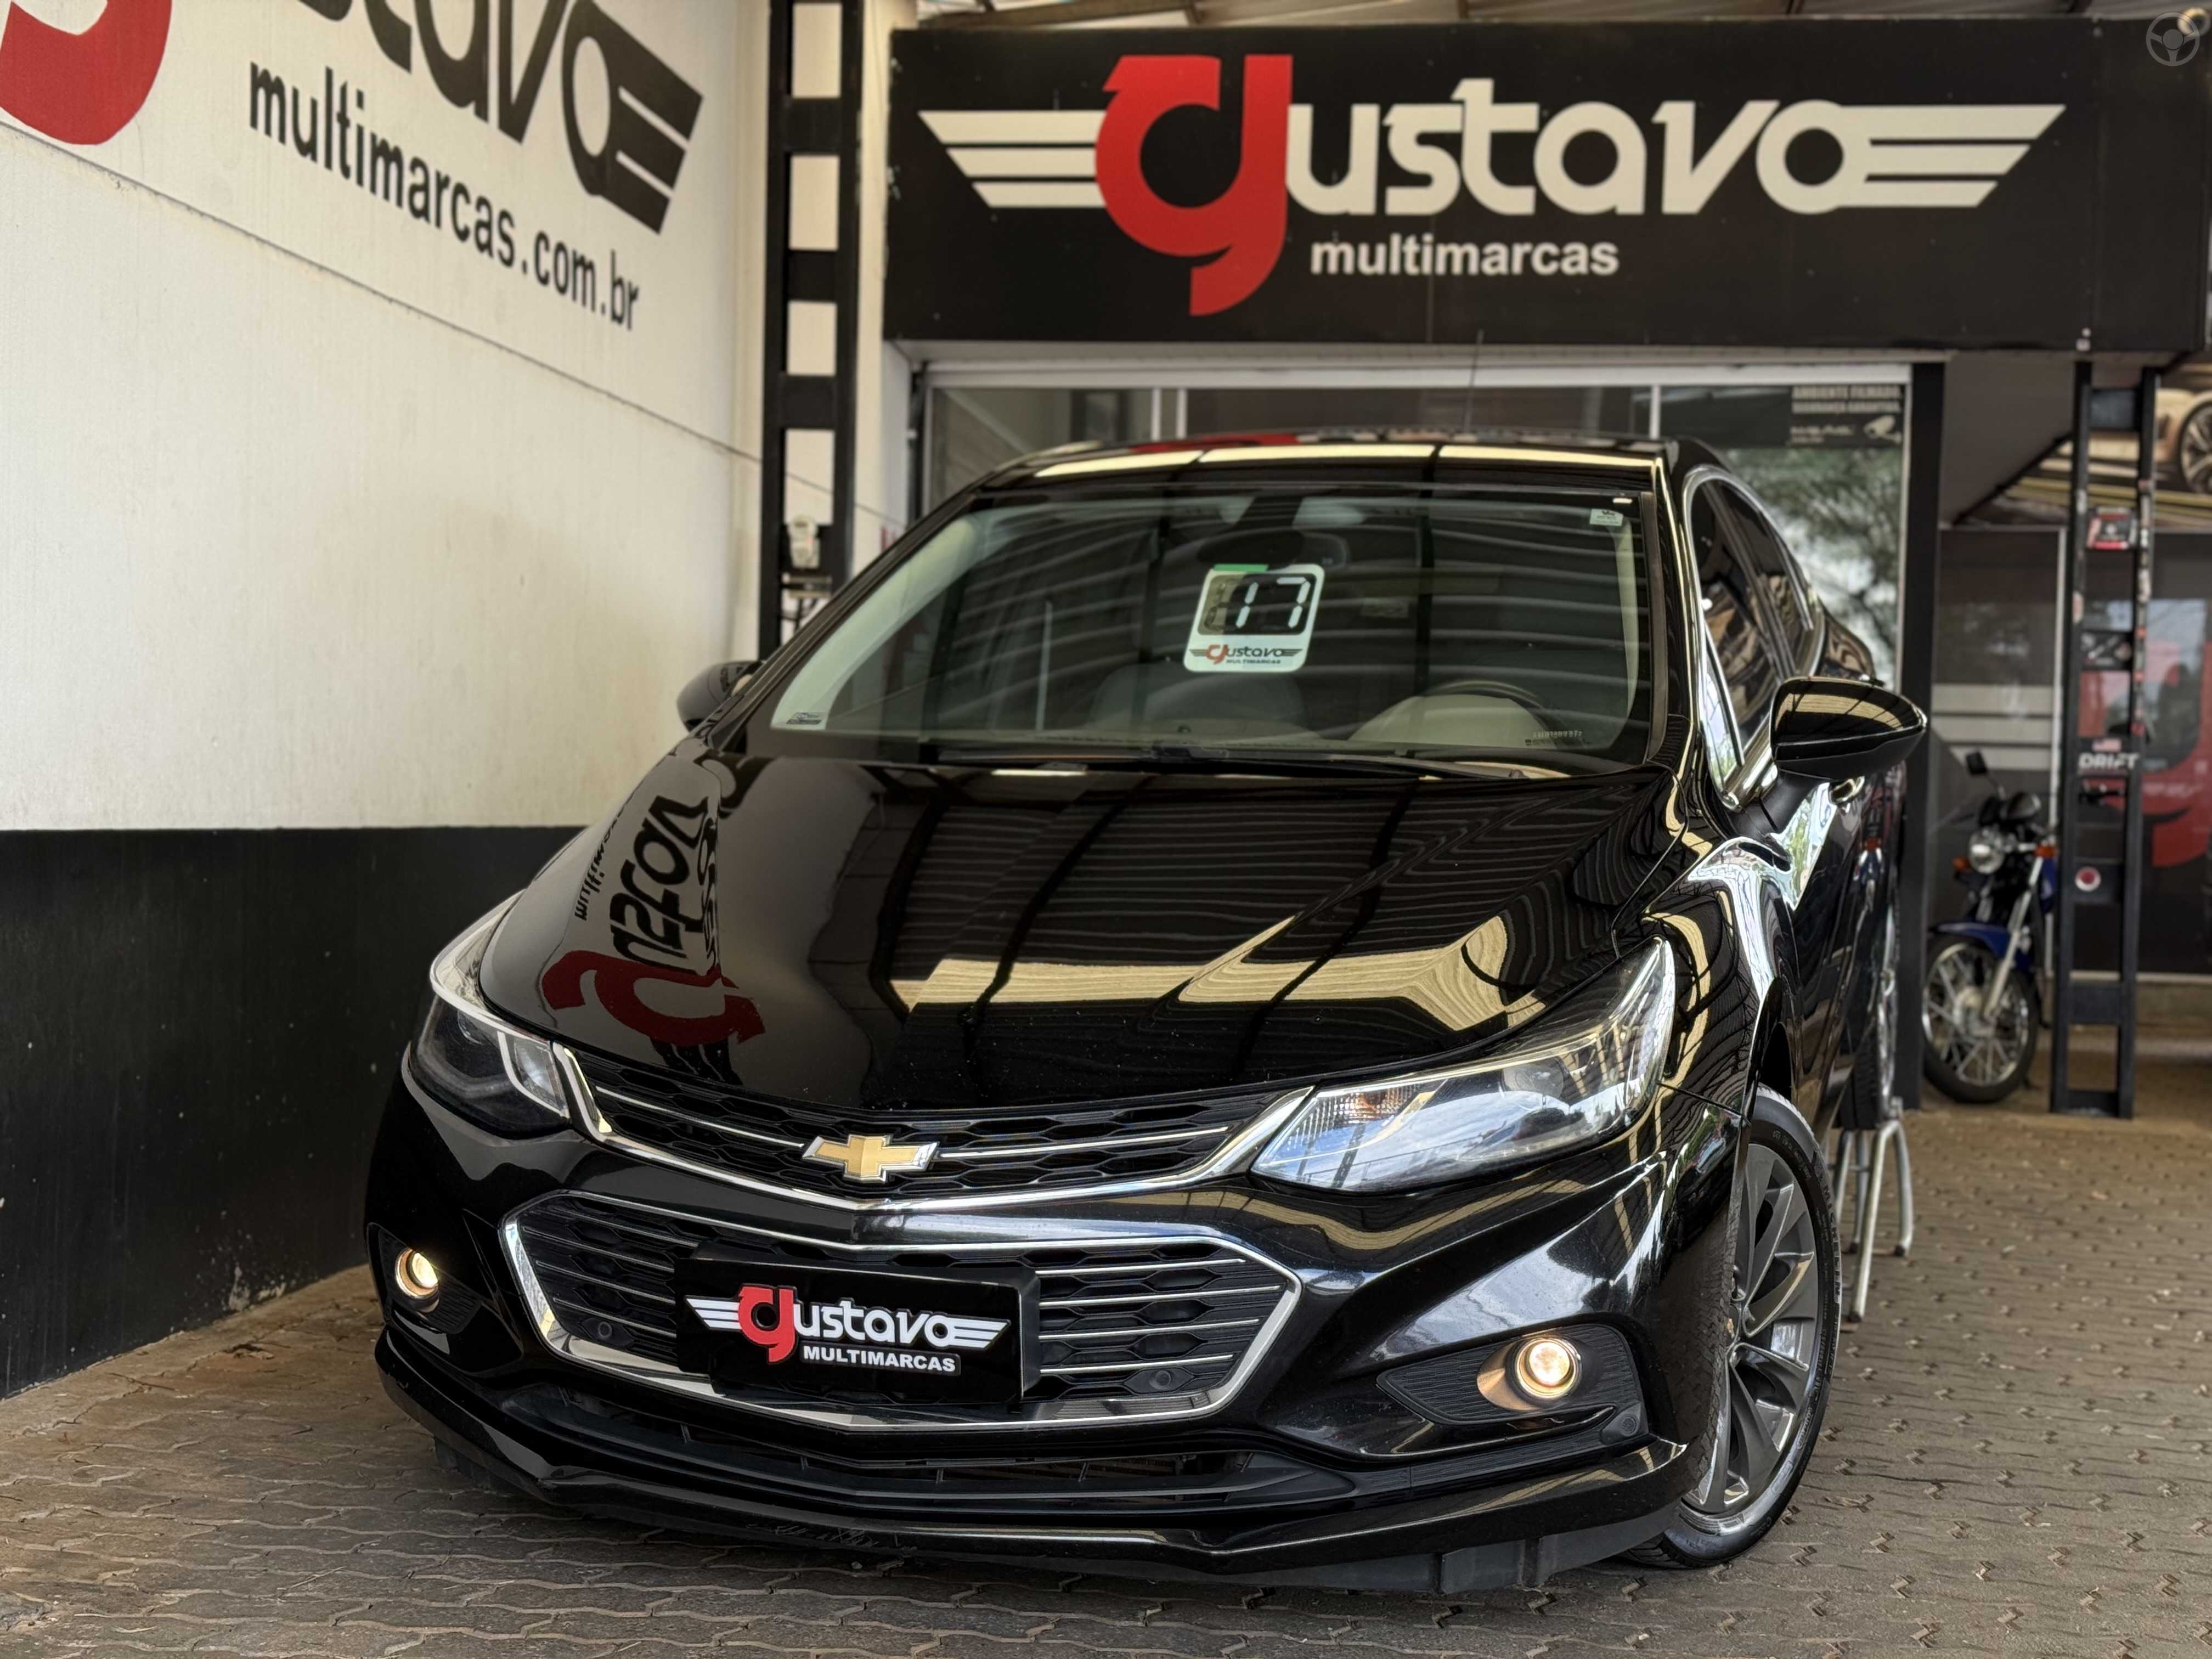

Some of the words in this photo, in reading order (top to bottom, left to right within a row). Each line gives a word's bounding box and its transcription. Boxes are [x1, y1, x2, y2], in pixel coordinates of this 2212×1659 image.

[250, 61, 639, 330] multimarcas.com.br
[1310, 234, 1619, 276] multimarcas
[2078, 752, 2140, 769] DRIFT
[803, 1345, 956, 1372] MULTIMARCAS
